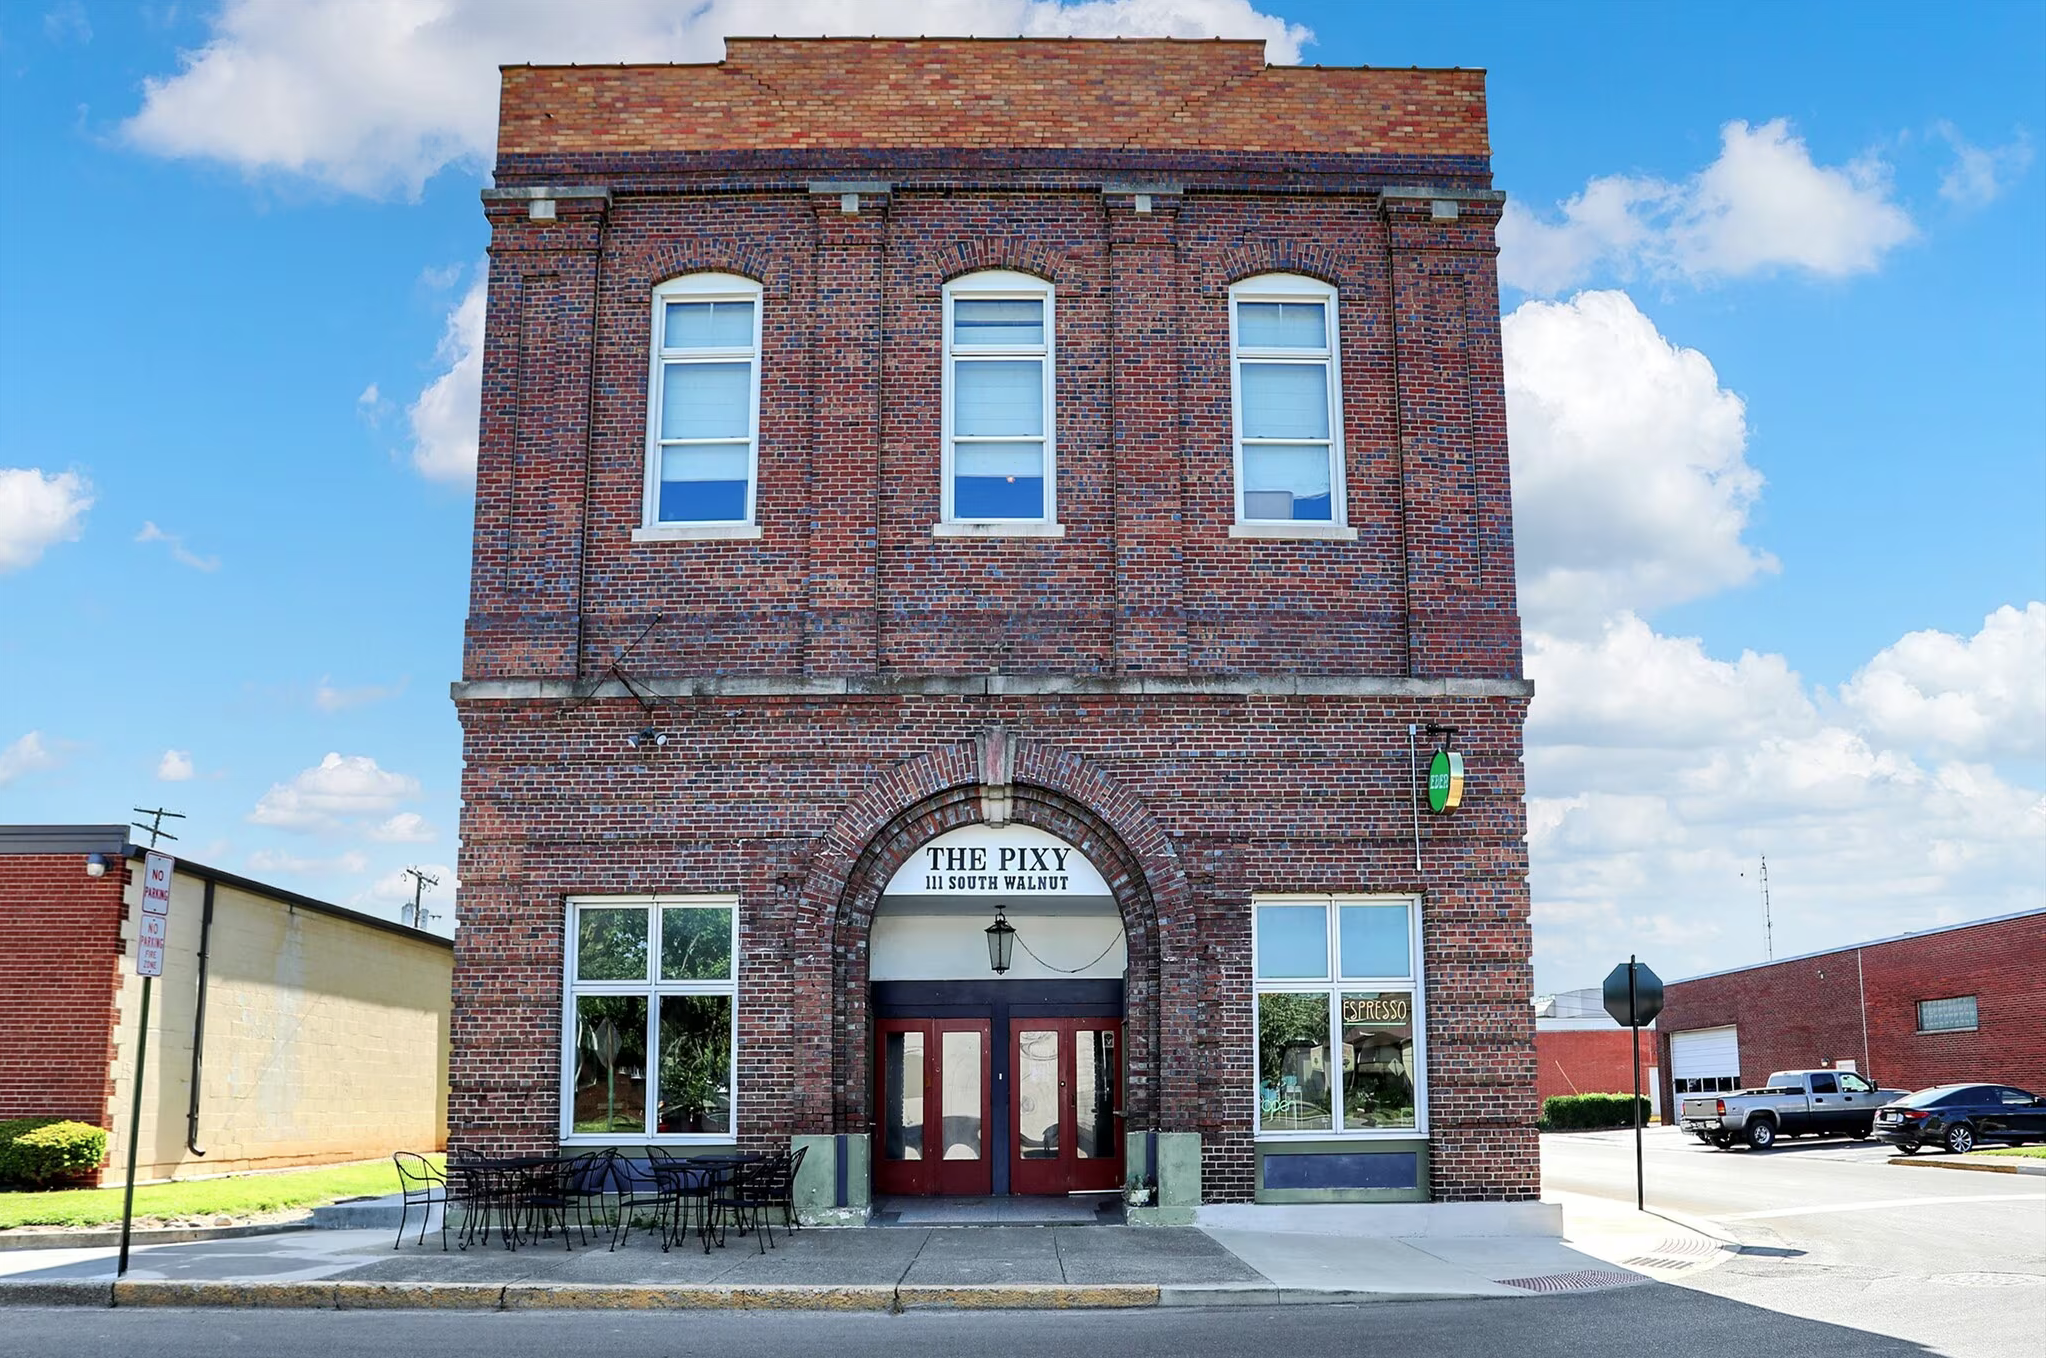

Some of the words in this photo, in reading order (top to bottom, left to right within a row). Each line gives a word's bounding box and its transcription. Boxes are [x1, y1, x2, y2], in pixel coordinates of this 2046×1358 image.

[927, 847, 986, 871] THE
[999, 847, 1071, 871] PIXY
[152, 869, 164, 882] NO
[925, 875, 943, 890] 111
[949, 875, 998, 890] SOUTH
[1004, 875, 1069, 890] WALNUT
[145, 887, 169, 901] PARKING
[148, 923, 159, 935] NO
[141, 935, 164, 949] PARKING
[145, 949, 157, 959] FIRE
[143, 960, 157, 970] ZONE
[1343, 1000, 1407, 1020] ESPRESSO
